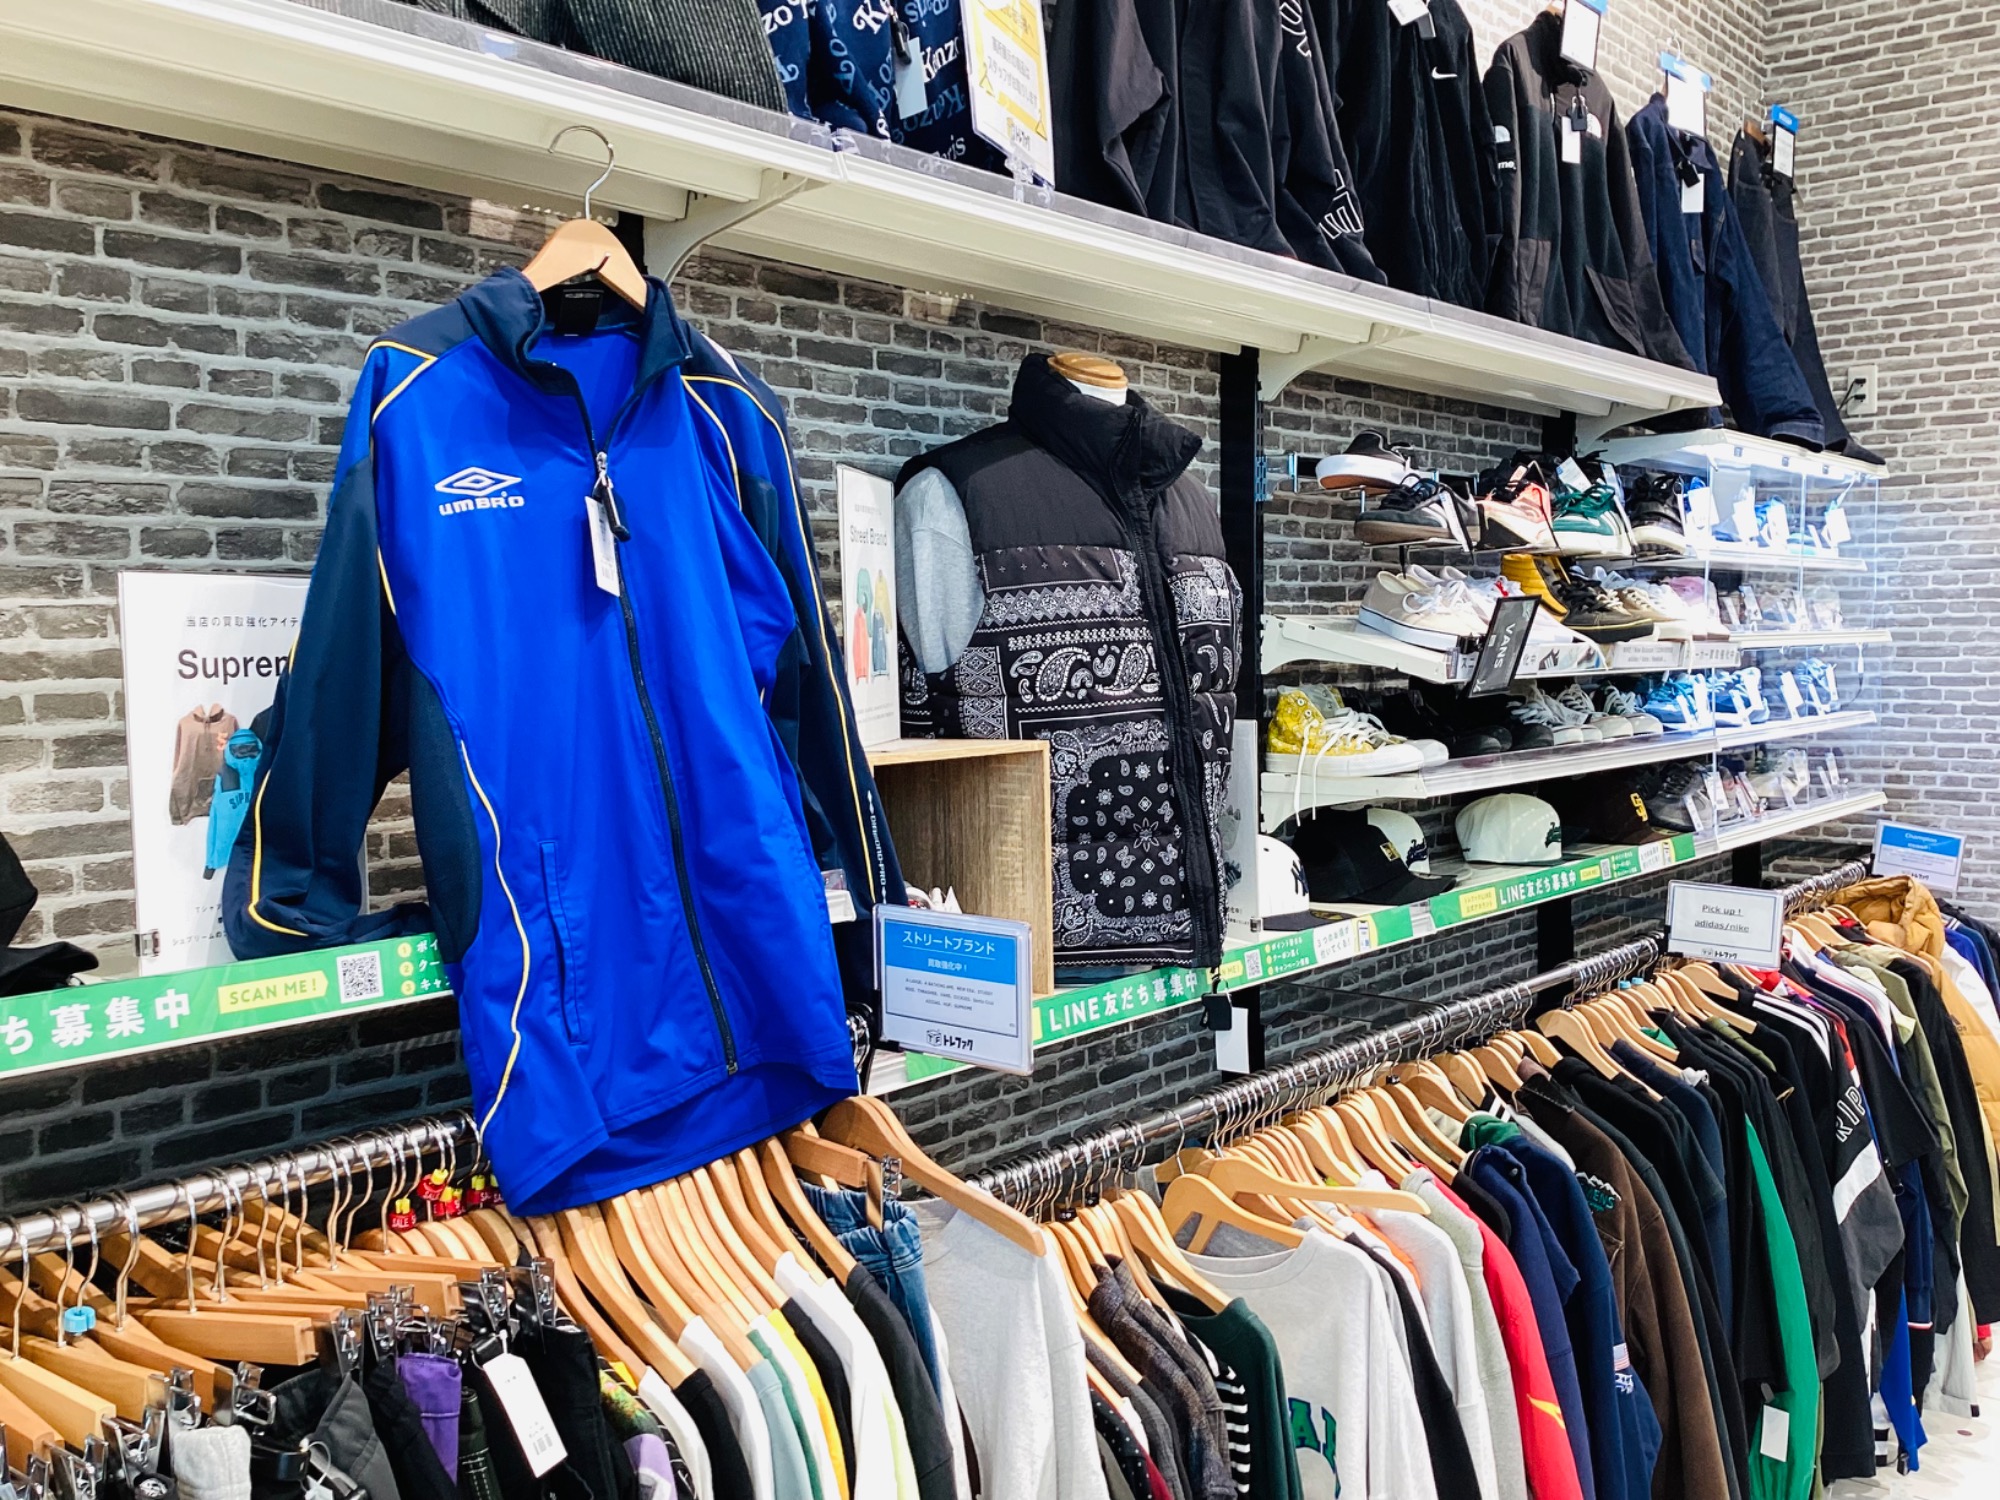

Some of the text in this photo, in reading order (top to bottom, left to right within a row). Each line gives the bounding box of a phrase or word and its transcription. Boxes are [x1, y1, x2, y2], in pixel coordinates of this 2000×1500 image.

[1494, 623, 1516, 669] VANS
[1702, 904, 1720, 913] Pick
[902, 930, 996, 955] ストリートブランド
[229, 984, 282, 1005] SCAN
[1, 988, 191, 1056] ち募集中
[391, 1217, 410, 1228] SALE
